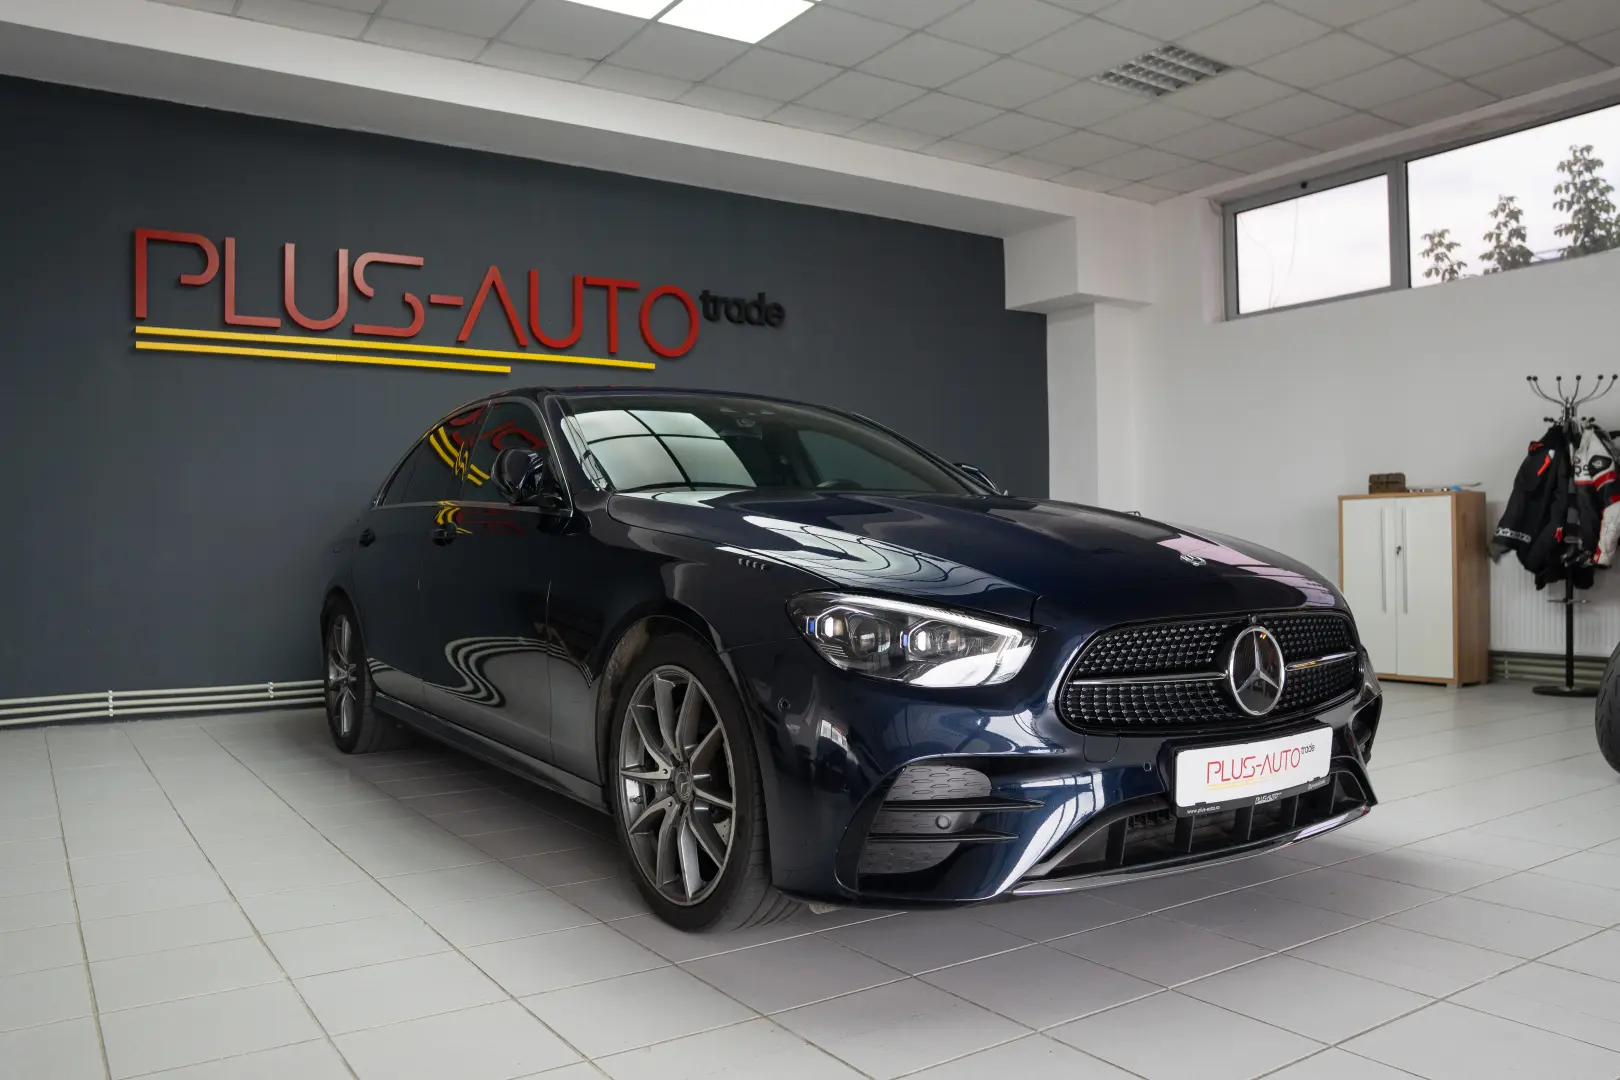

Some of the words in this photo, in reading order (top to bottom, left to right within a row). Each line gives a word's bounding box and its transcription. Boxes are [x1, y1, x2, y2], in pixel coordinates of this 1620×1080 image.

[135, 228, 701, 358] PLUS-AUTO
[700, 289, 786, 328] trade
[1206, 747, 1301, 784] PLUS-AUTO
[1300, 742, 1316, 756] trade
